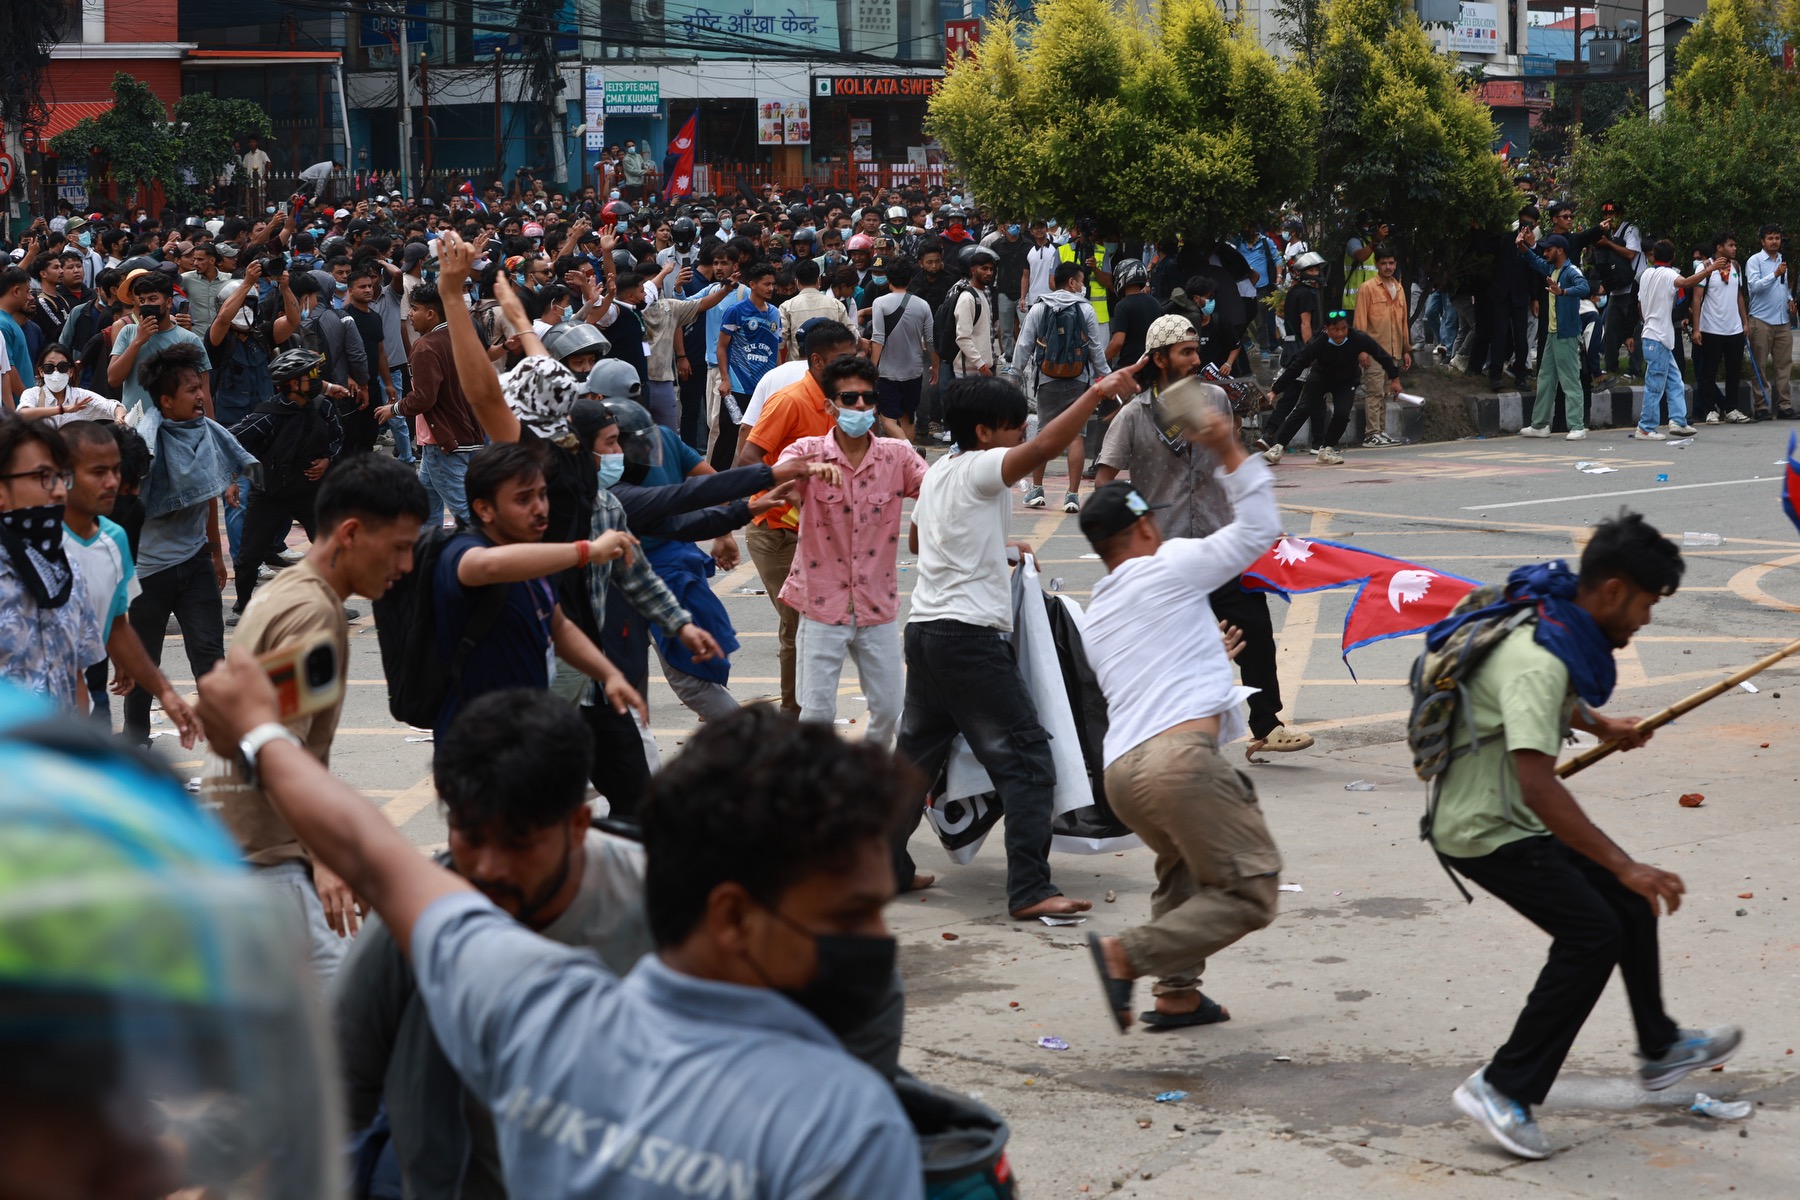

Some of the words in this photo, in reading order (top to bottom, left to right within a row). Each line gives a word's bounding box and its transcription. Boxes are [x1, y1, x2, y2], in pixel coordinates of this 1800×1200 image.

[728, 8, 776, 34] आँखा
[781, 8, 819, 35] केन्द्र
[1472, 18, 1497, 28] EDUCATION
[605, 82, 624, 92] IELTS
[625, 82, 638, 92] PTE
[639, 82, 658, 92] GMAT
[834, 78, 899, 95] KOLKATA
[605, 94, 626, 103] CMAT
[627, 94, 658, 103] KUUMAT
[606, 105, 632, 113] KANTIPUR
[633, 105, 658, 113] ACADEMY
[61, 186, 86, 198] ATM
[502, 1086, 764, 1200] HIKVISION
